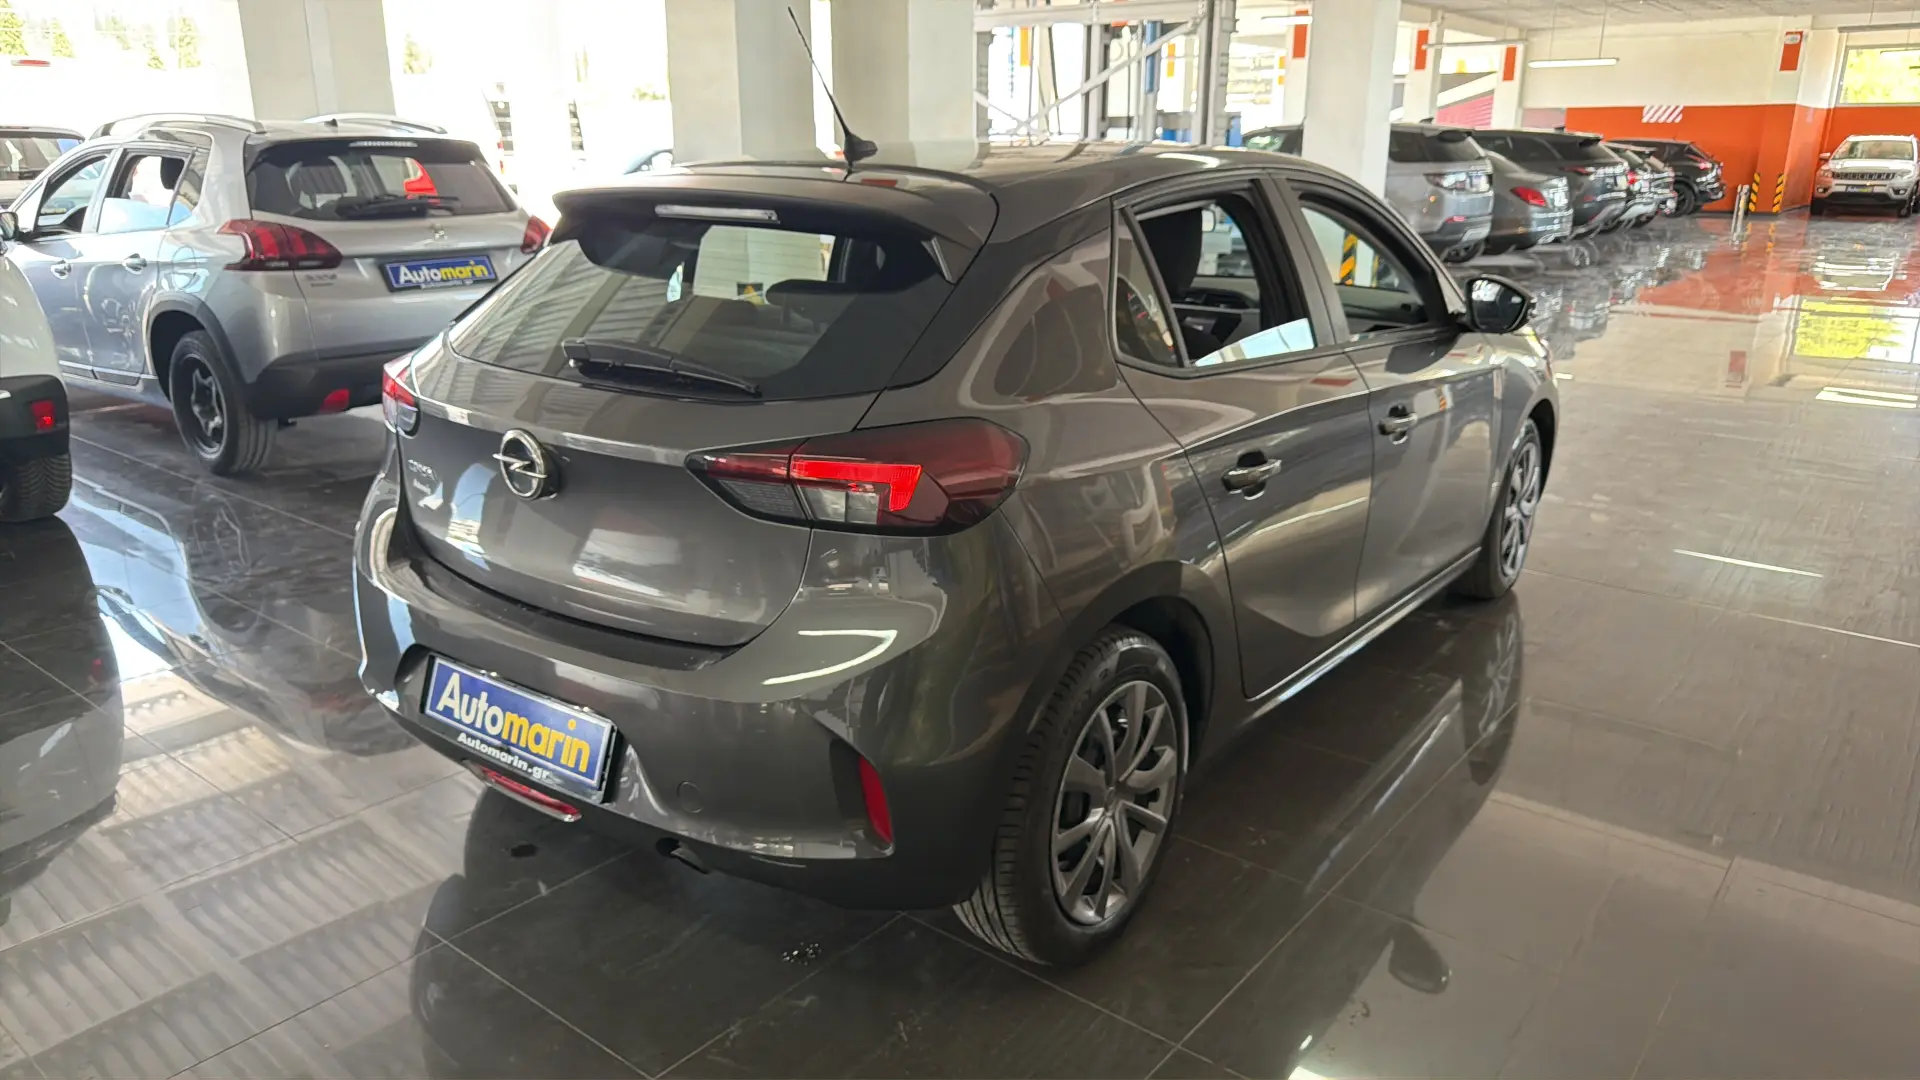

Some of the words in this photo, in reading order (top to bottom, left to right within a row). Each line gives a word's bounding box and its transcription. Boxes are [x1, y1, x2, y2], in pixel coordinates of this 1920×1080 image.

[400, 260, 488, 284] Automarin
[436, 672, 590, 773] Automarin
[457, 732, 550, 780] Automarin.gr
